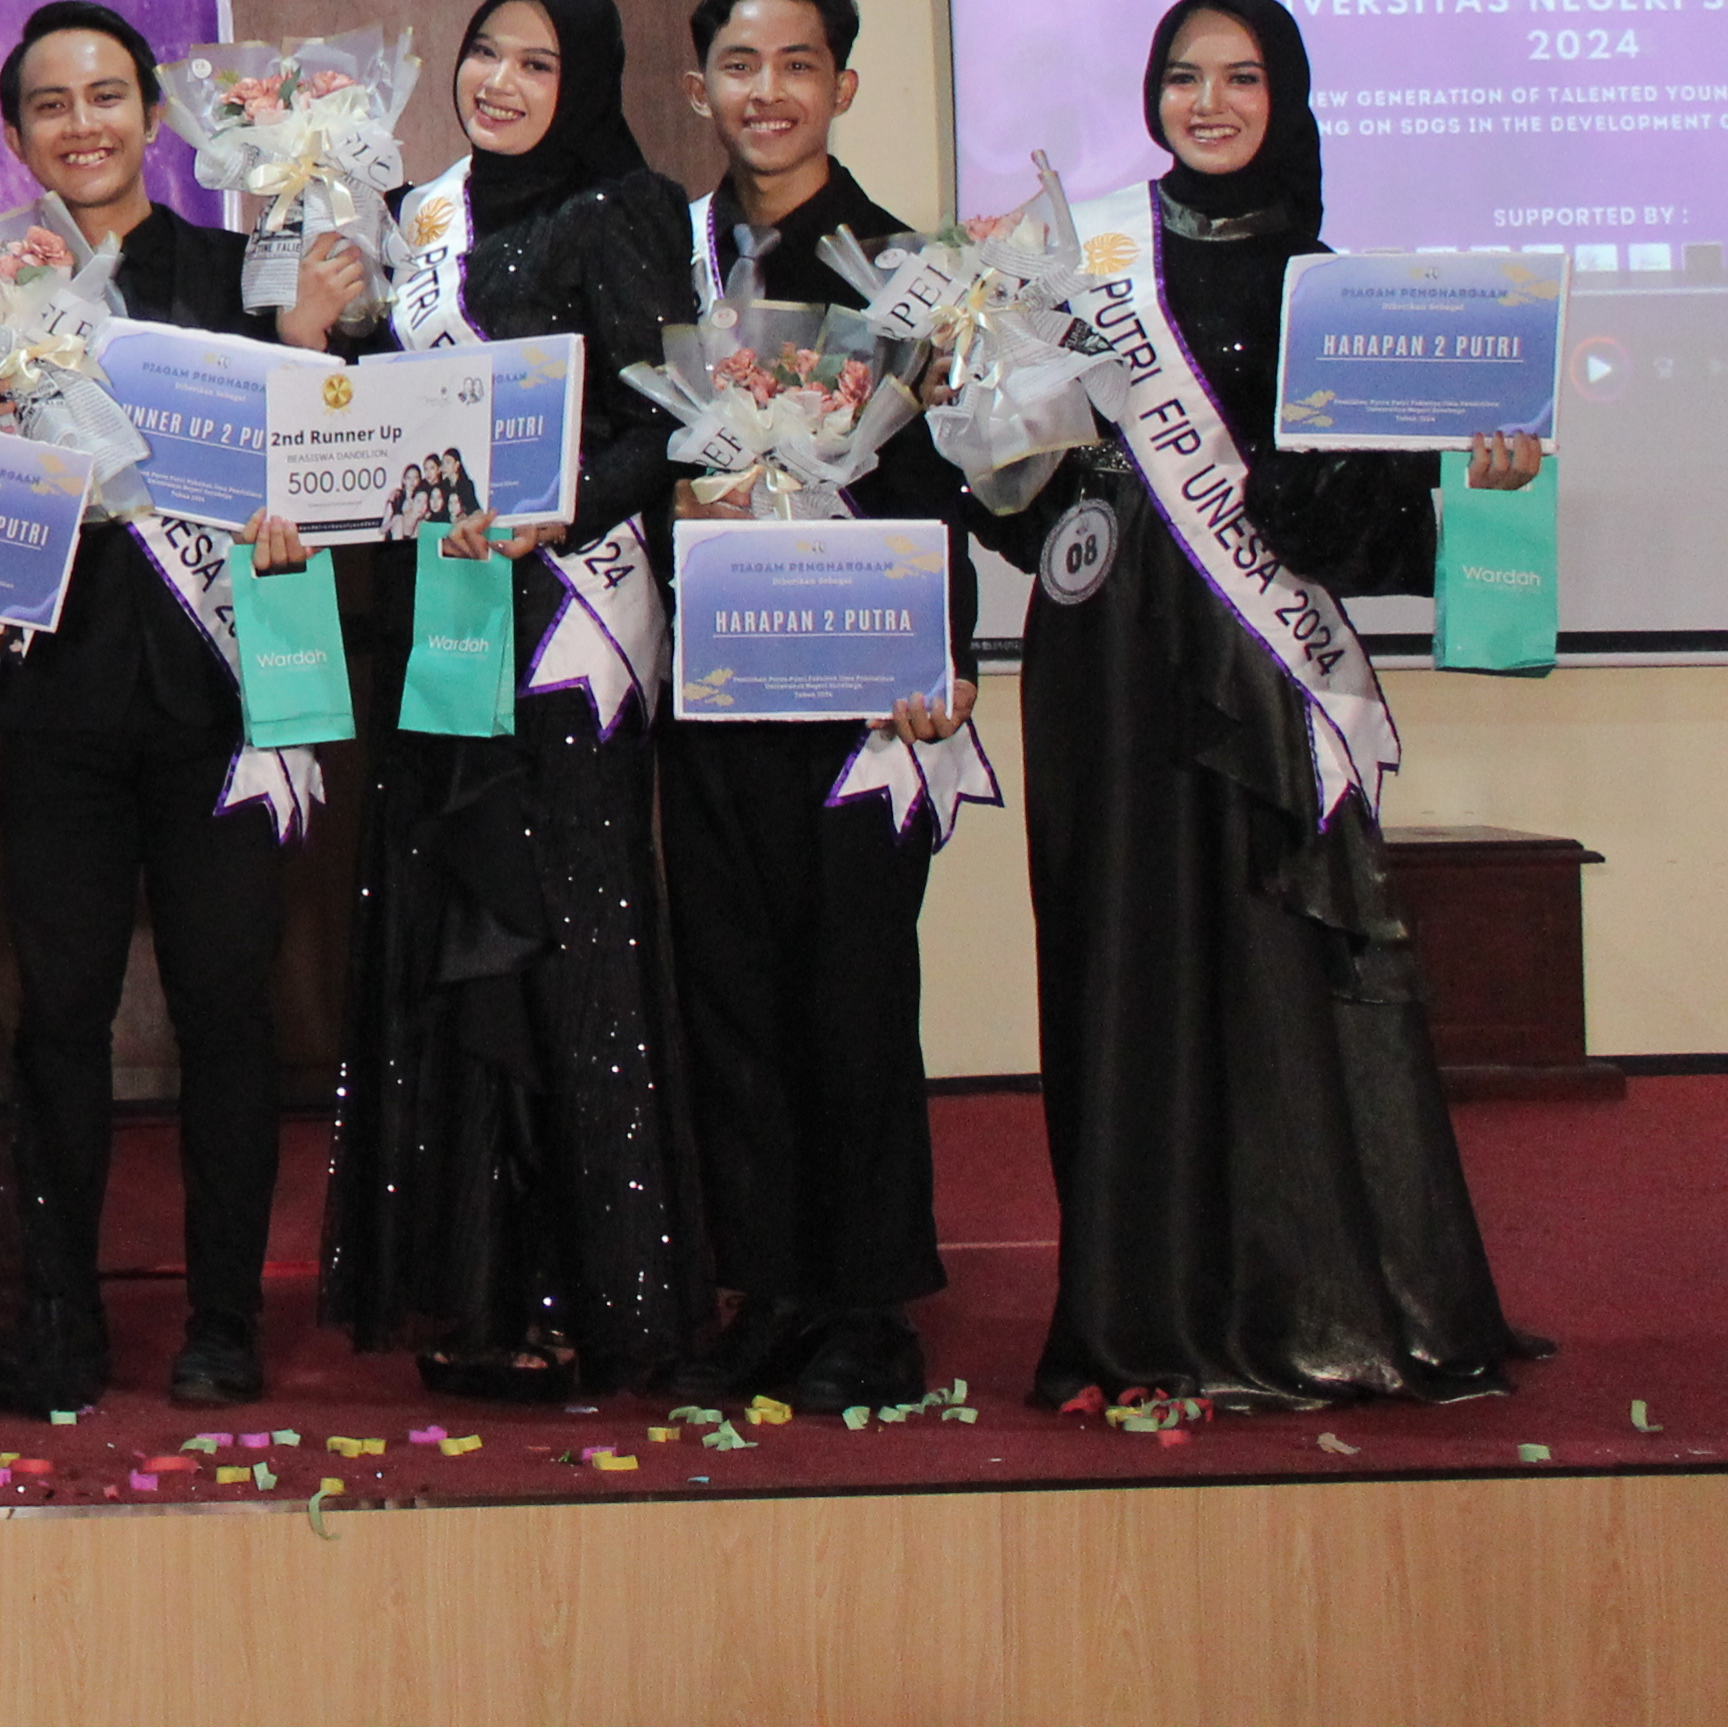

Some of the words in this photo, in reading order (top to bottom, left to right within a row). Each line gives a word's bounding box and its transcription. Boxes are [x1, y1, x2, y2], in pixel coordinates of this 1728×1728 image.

[1527, 29, 1640, 60] 2024
[1356, 88, 1503, 107] GENERATION
[1511, 87, 1540, 104] OF
[1548, 85, 1657, 103] TALENTED
[1359, 118, 1392, 135] ON
[1400, 118, 1461, 135] SDGS
[1469, 117, 1493, 134] IN
[1502, 116, 1542, 133] THE
[1550, 114, 1711, 133] DEVELOPMENT
[1493, 207, 1635, 226] SUPPORTED
[1644, 207, 1676, 225] BY
[1322, 334, 1424, 356] HARAPAN
[1433, 335, 1446, 356] 2
[1455, 335, 1520, 358] PUTRI
[192, 372, 267, 393] PENGHARGA
[122, 403, 183, 434] UNNER
[189, 417, 215, 439] UP
[220, 423, 233, 444] 2
[494, 415, 544, 440] PUTRI
[271, 429, 305, 447] 2nd
[310, 429, 376, 445] Runner
[380, 425, 403, 444] Up
[287, 467, 387, 495] 500.000
[1090, 277, 1161, 388] PUTRI
[1138, 397, 1201, 460] FIP
[1181, 462, 1287, 595] UNESA
[1274, 589, 1345, 676] 2024
[162, 518, 228, 593] ESA
[1065, 534, 1098, 575] 08
[1462, 564, 1542, 588] Wardah
[715, 609, 814, 633] HARAPAN
[824, 609, 835, 632] 2
[844, 608, 912, 632] PUTRA
[427, 634, 490, 654] Wardah
[255, 649, 327, 670] Wardah
